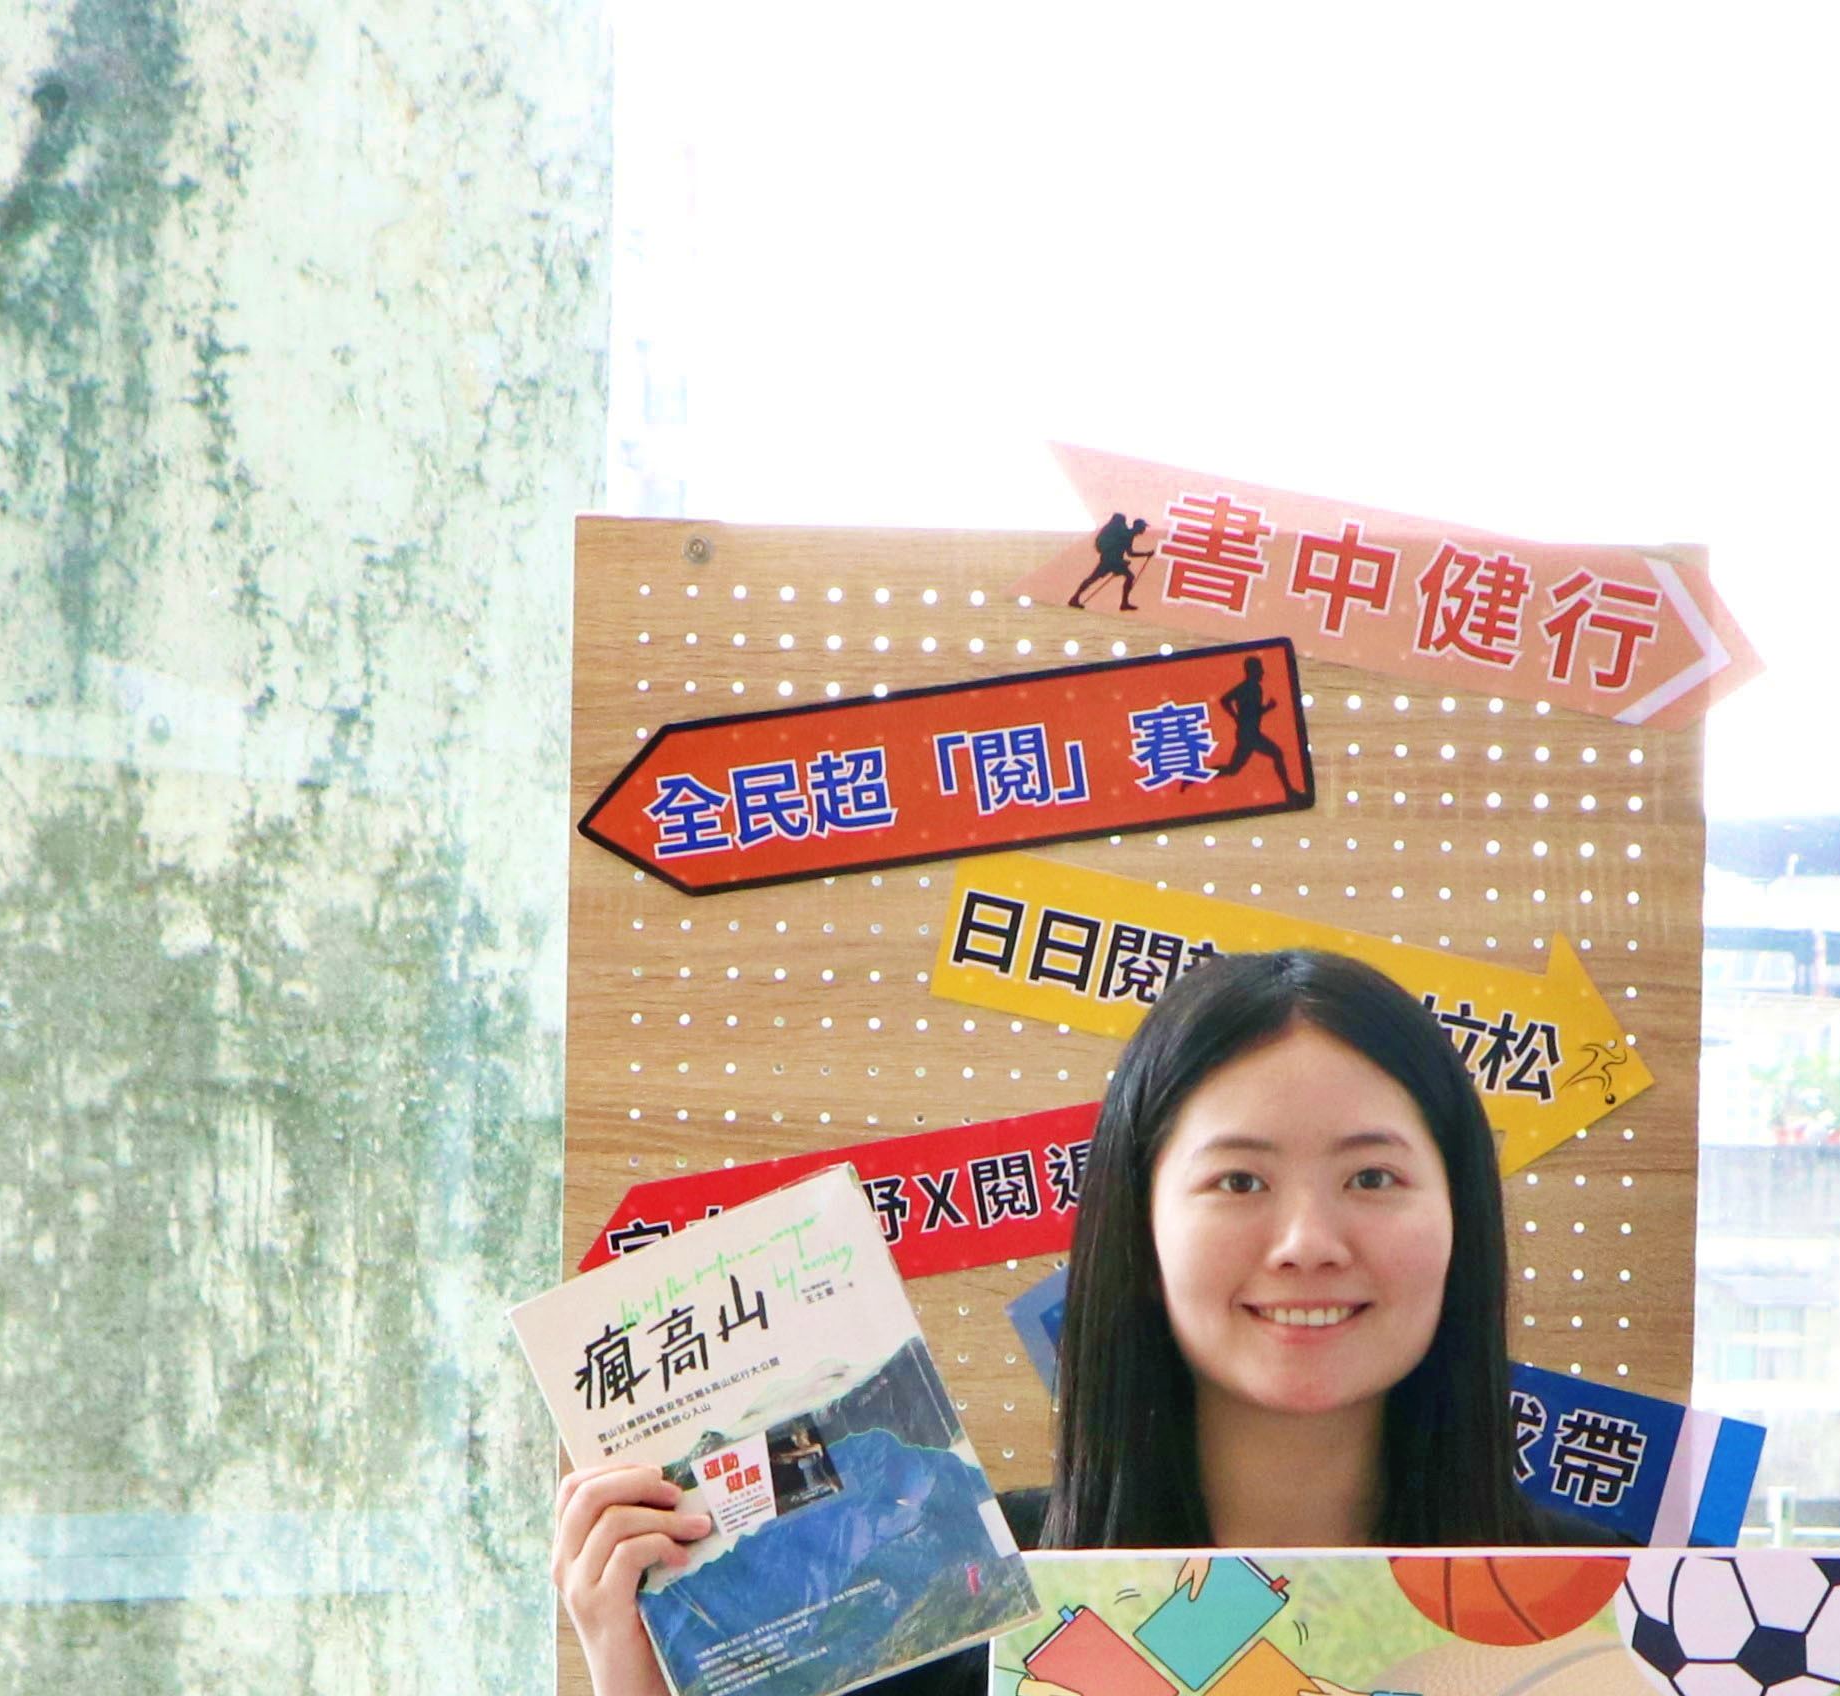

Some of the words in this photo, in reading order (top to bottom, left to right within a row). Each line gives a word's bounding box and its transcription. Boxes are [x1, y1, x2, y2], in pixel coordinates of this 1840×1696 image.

[1157, 489, 1662, 693] 書中健行
[650, 701, 1217, 858] 全民超「閱」賽
[575, 1274, 768, 1409] 瘋高山
